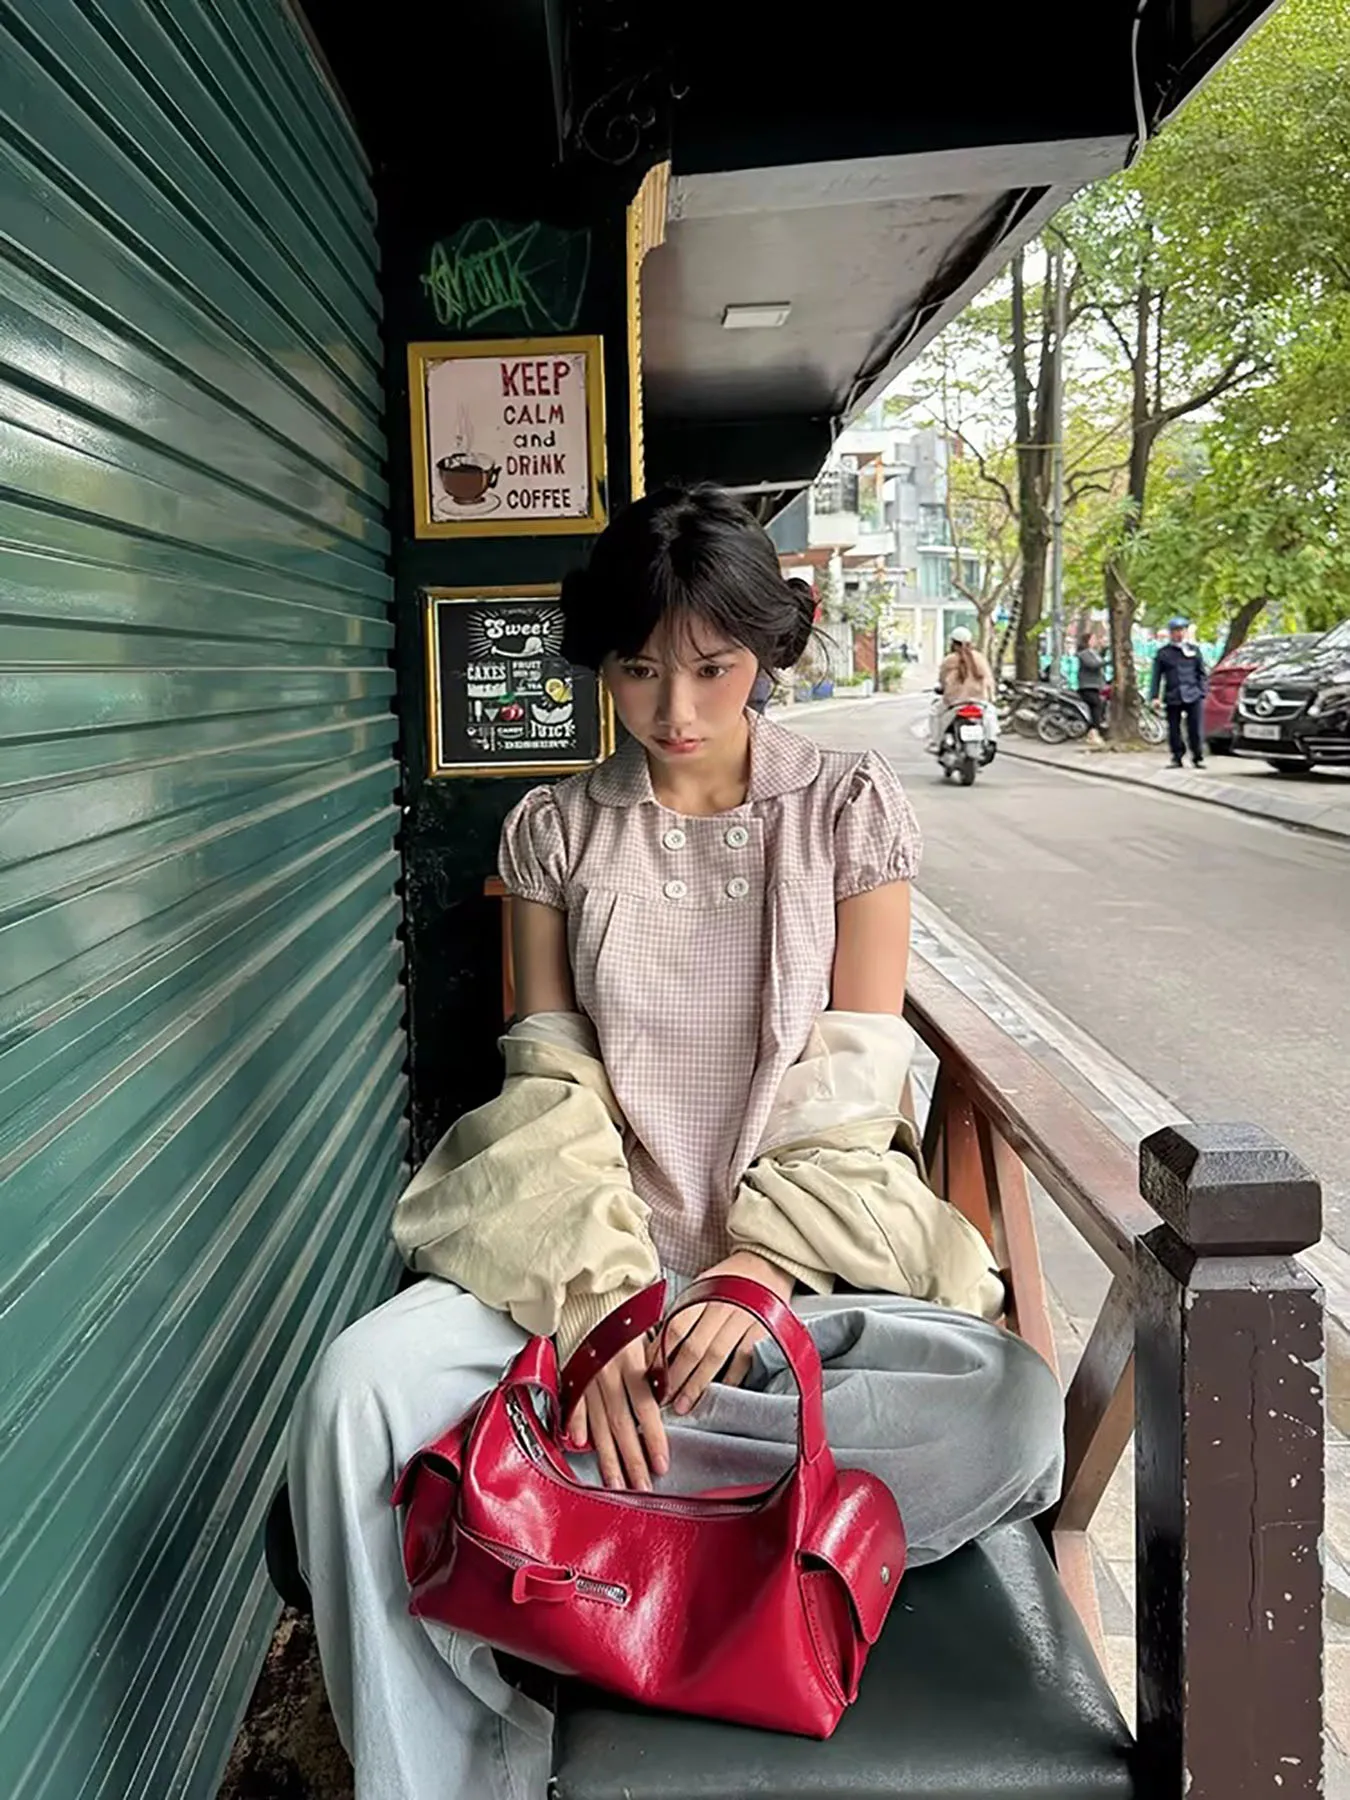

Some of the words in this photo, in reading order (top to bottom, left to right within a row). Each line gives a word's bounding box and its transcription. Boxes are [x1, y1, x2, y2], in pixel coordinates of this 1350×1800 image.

[500, 361, 571, 396] KEEP
[504, 404, 565, 425] CALM
[513, 430, 556, 448] and
[507, 488, 571, 509] COFFEE
[484, 618, 551, 638] Sweet
[467, 664, 506, 681] CAKES
